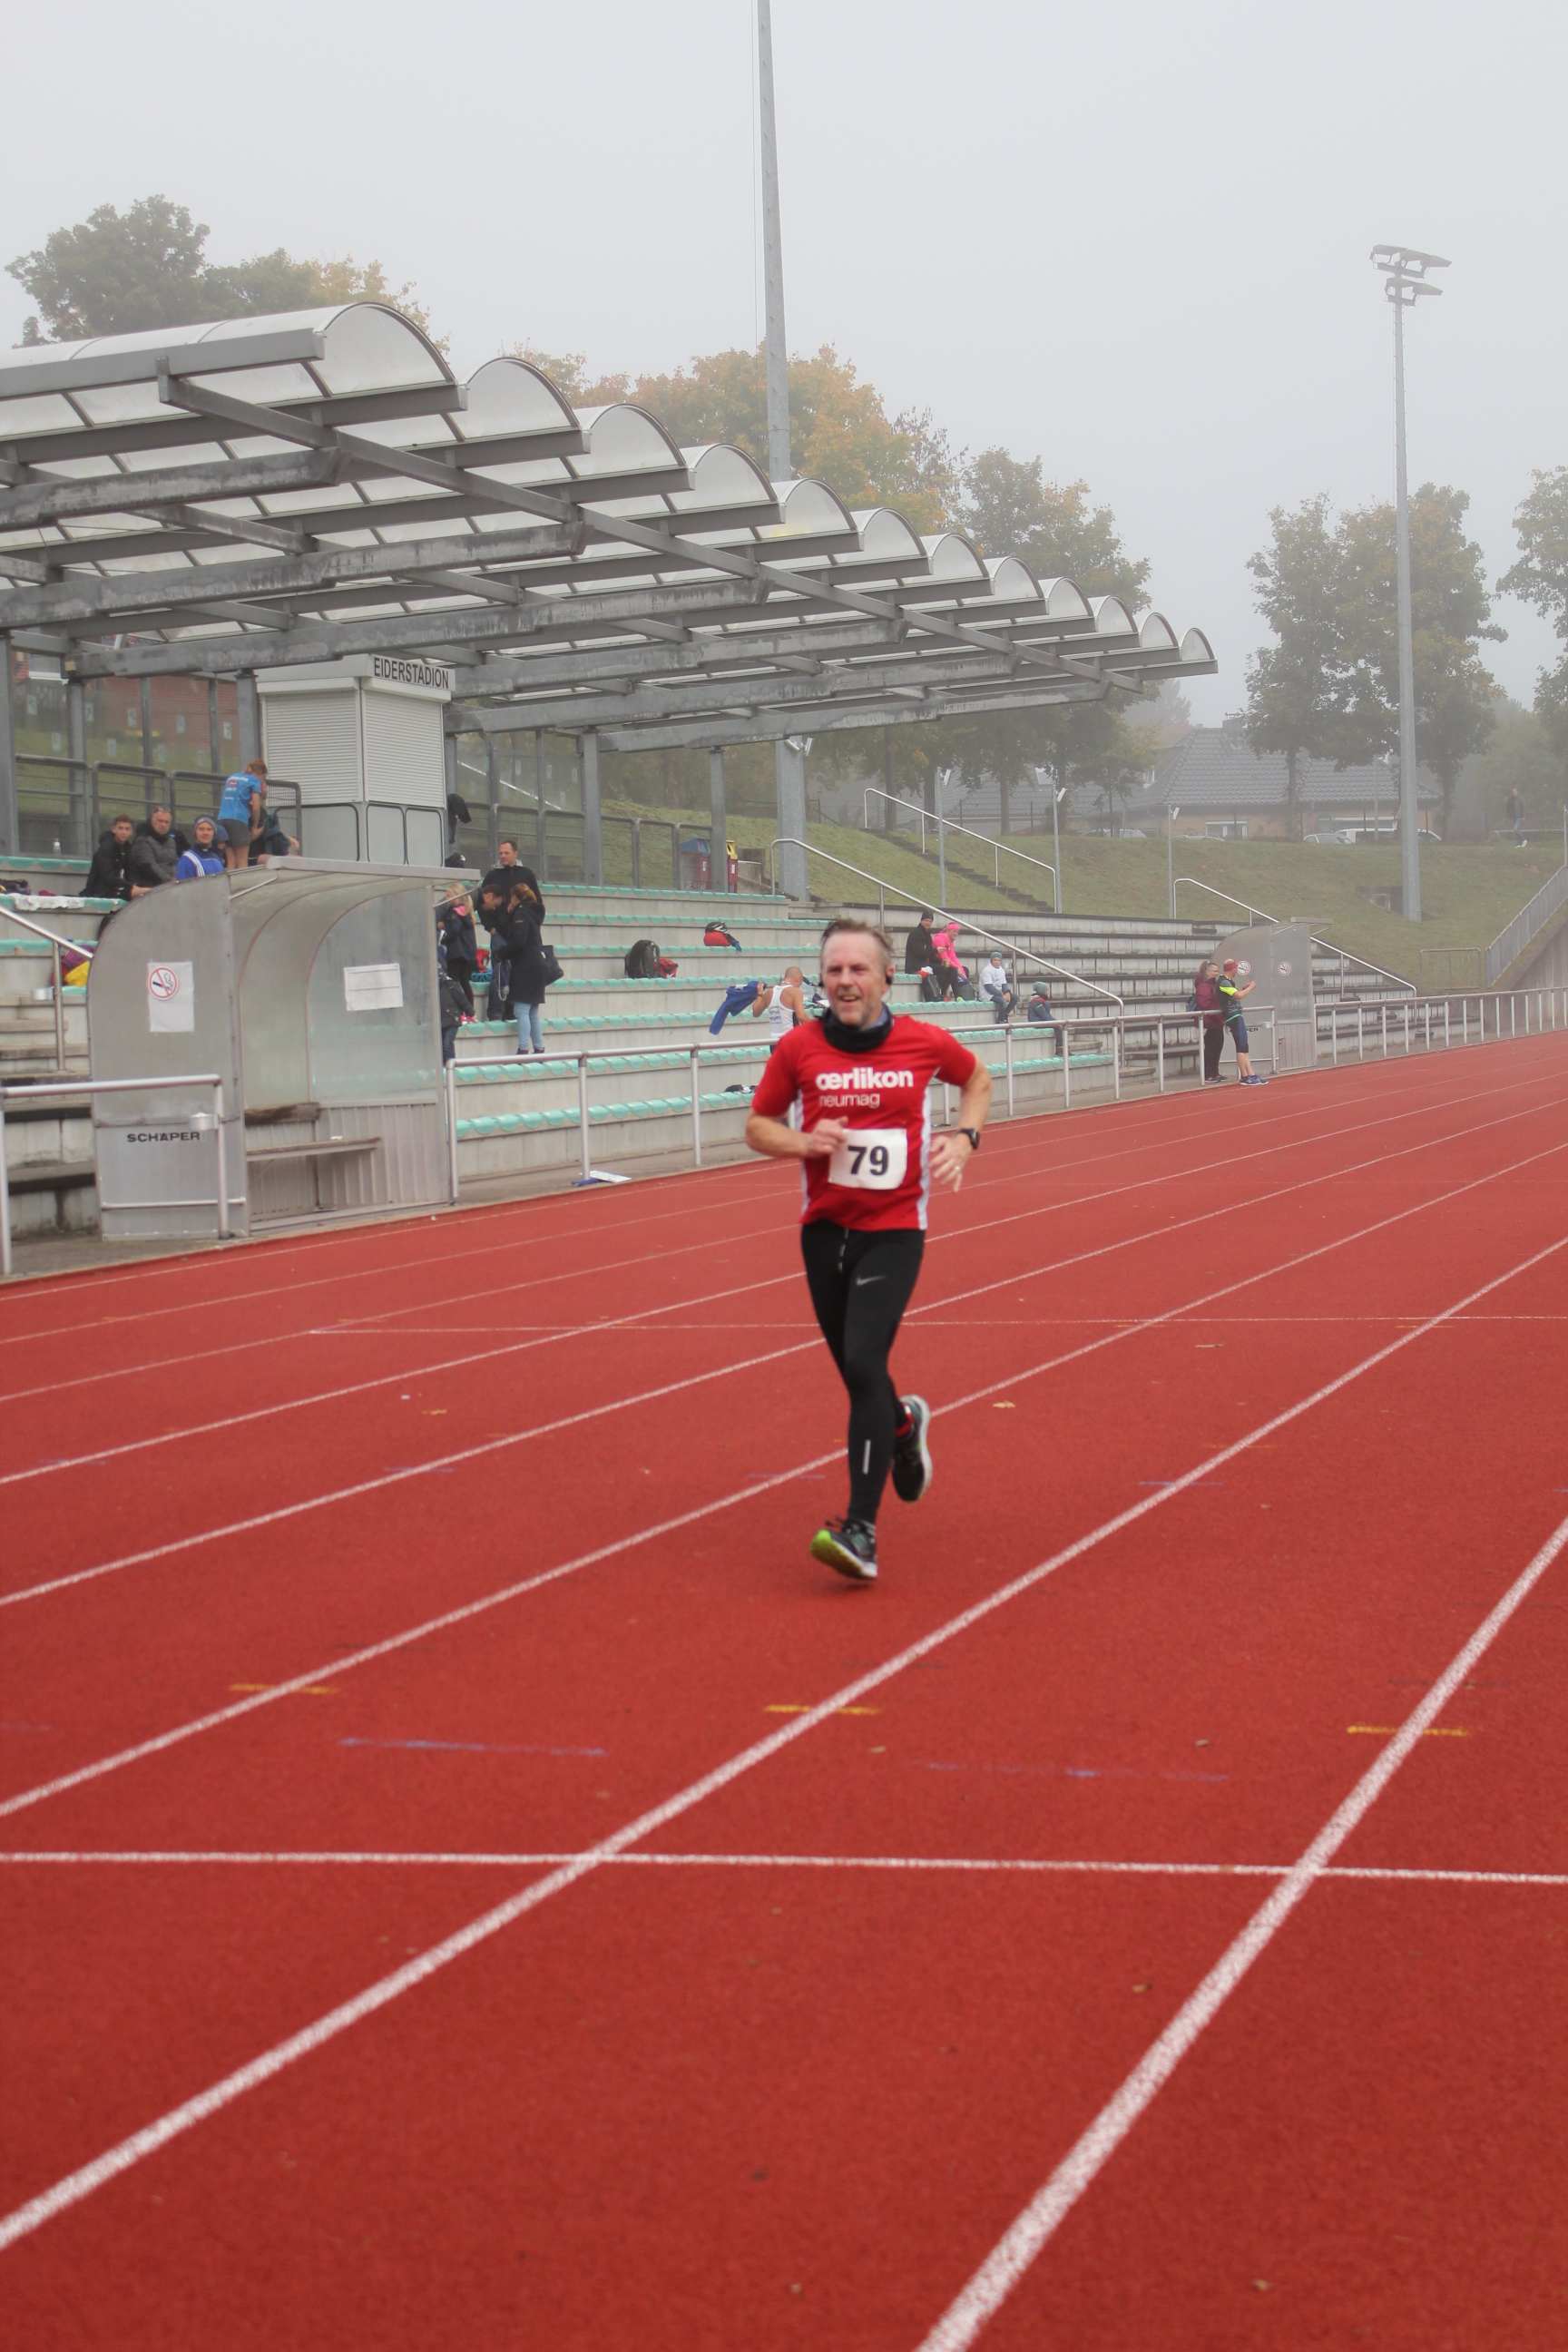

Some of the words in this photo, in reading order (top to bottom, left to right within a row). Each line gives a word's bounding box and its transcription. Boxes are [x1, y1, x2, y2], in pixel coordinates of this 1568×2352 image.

[374, 657, 449, 690] EIDERSTADION
[819, 1093, 880, 1109] neumag
[848, 1145, 888, 1175] 79
